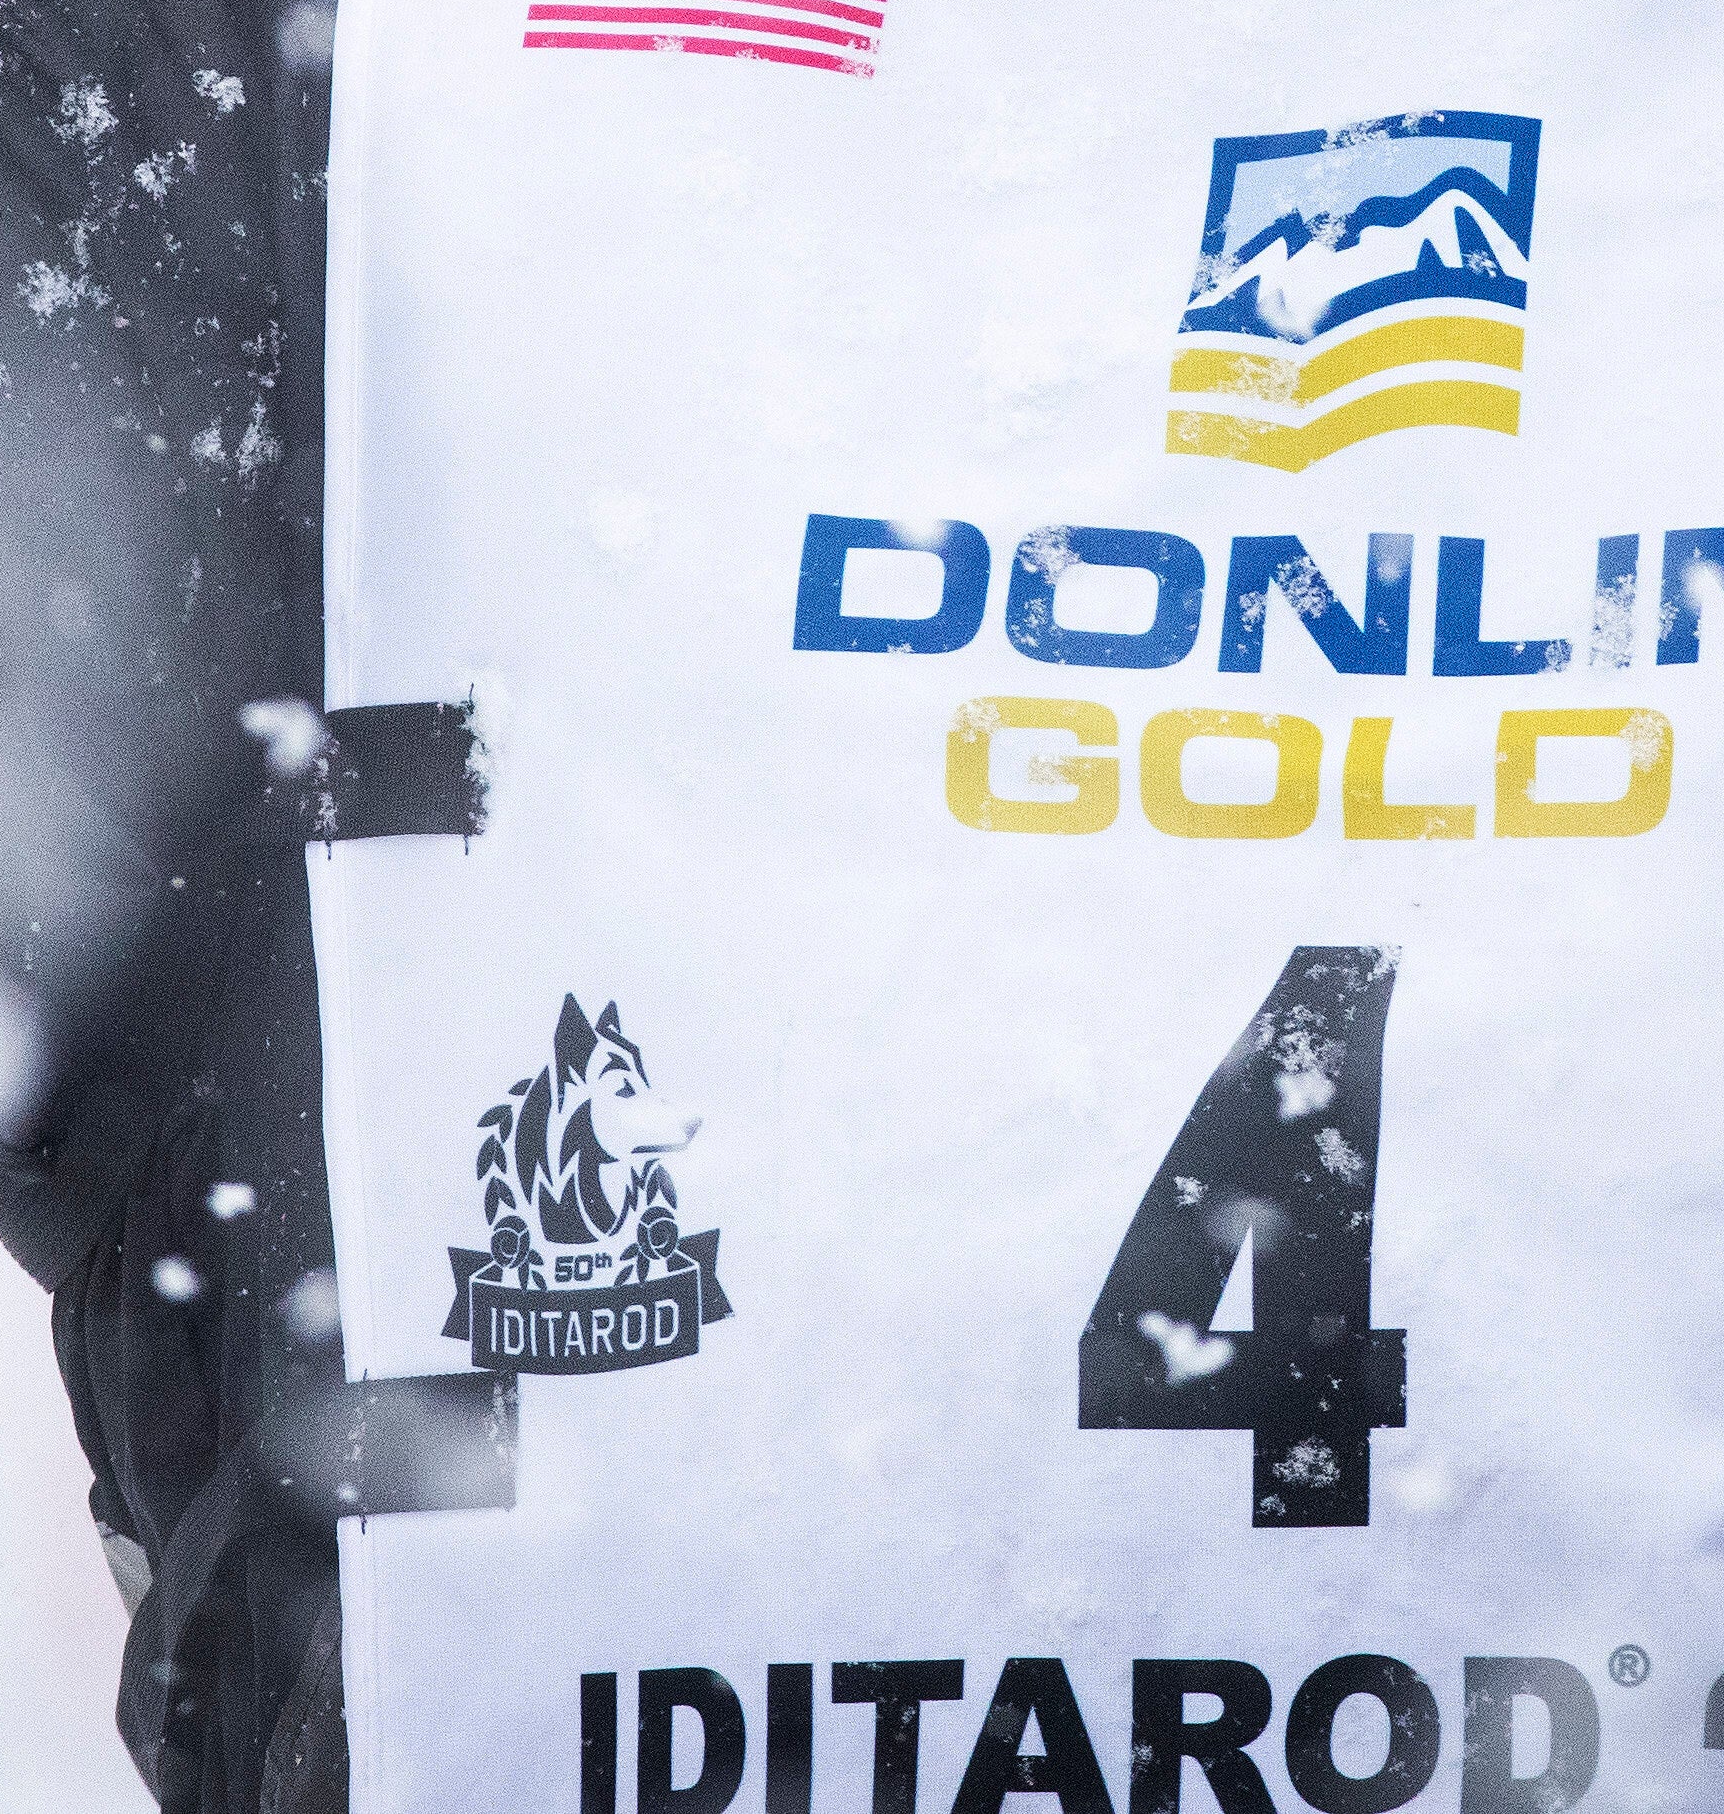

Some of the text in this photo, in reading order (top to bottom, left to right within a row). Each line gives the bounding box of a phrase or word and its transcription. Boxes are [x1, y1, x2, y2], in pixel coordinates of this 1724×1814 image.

[944, 695, 1675, 841] GOLD
[554, 1250, 614, 1284] 50th
[1078, 945, 1408, 1527] 4
[489, 1297, 681, 1358] IDITAROD
